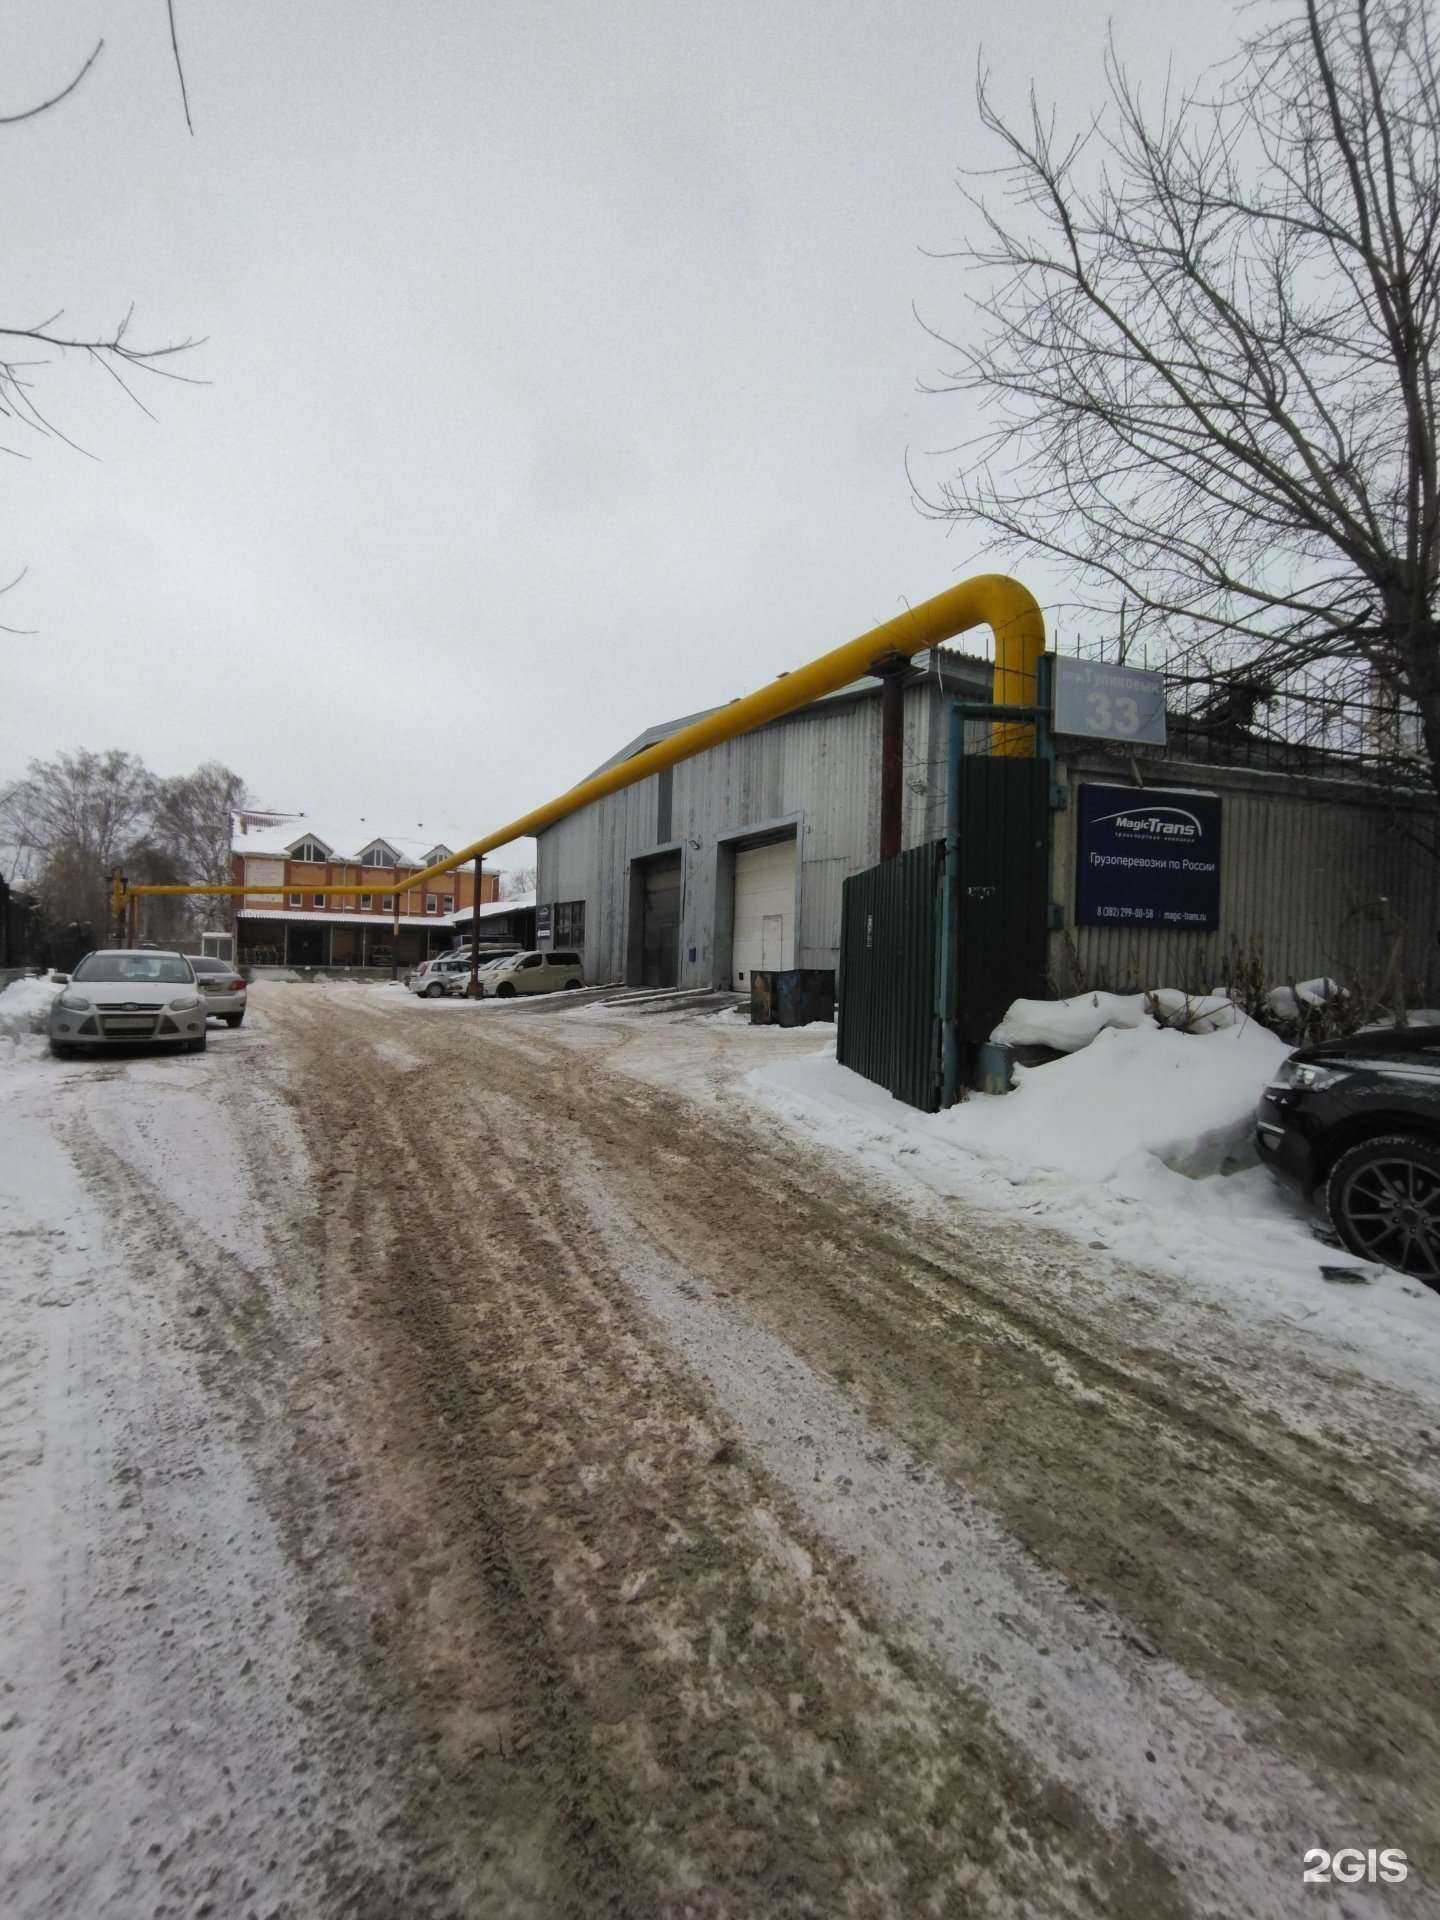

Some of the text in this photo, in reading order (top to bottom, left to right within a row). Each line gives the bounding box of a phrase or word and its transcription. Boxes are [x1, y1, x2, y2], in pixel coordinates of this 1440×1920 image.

[1086, 691, 1139, 734] 33
[1115, 817, 1196, 835] MagicTrans
[1090, 852, 1215, 872] Грузоперевозки по России
